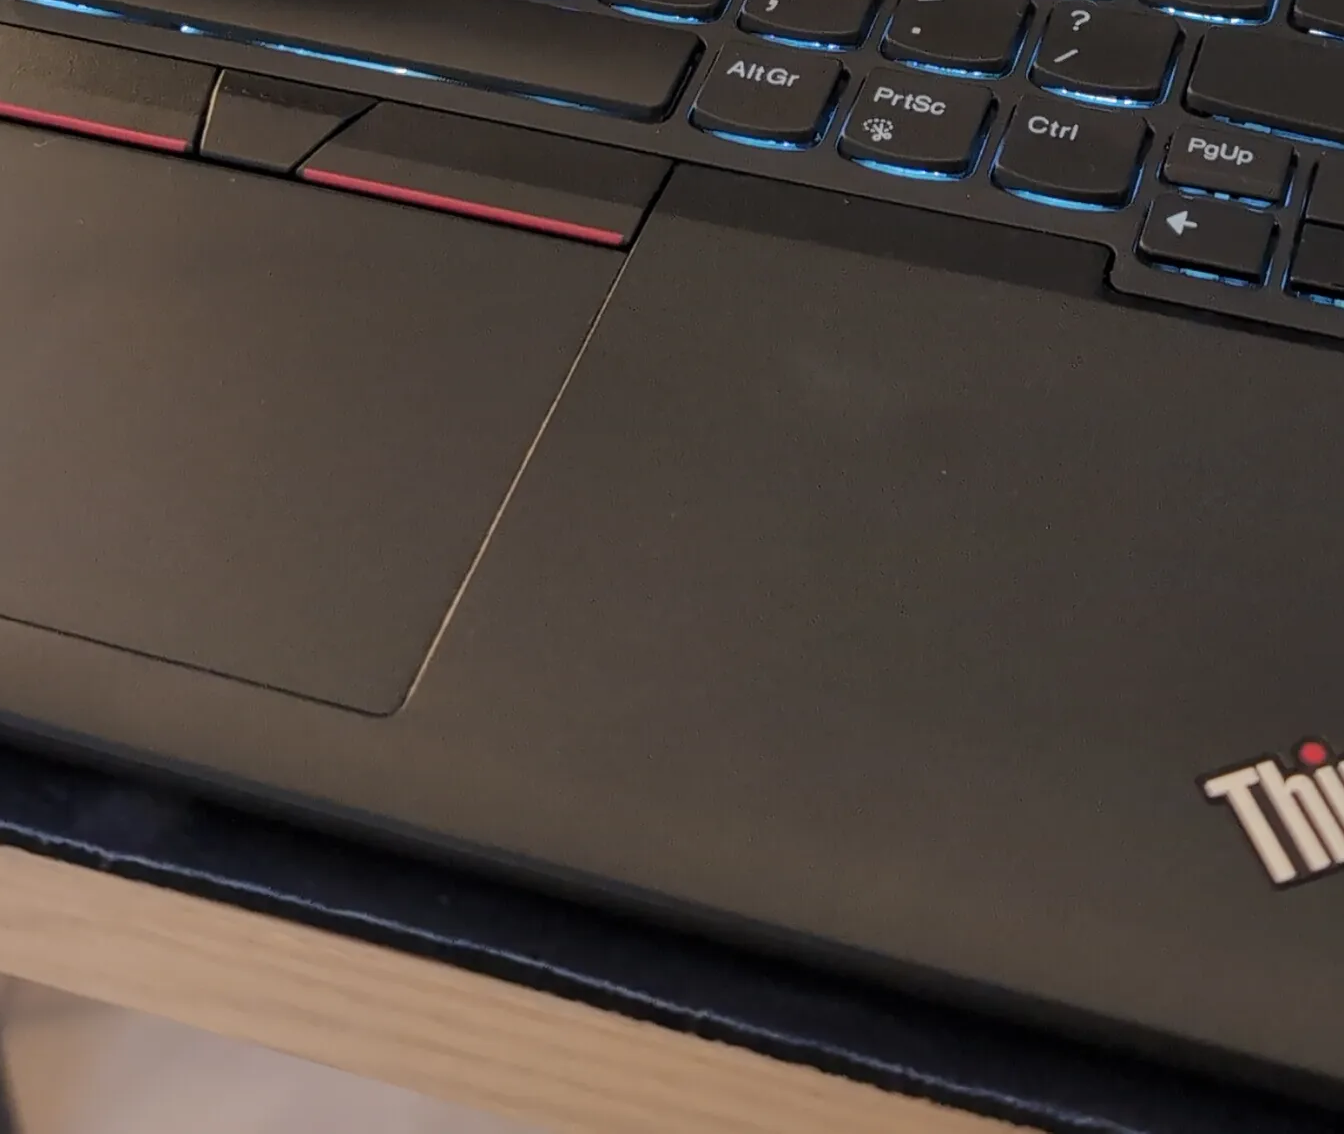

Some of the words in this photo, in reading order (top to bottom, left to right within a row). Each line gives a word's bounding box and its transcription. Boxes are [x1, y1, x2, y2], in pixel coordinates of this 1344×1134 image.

[1070, 10, 1091, 31] ?
[726, 60, 800, 88] AltGr
[873, 87, 947, 116] PrtSc
[1027, 116, 1080, 142] Ctrl
[1187, 138, 1254, 165] PgUp
